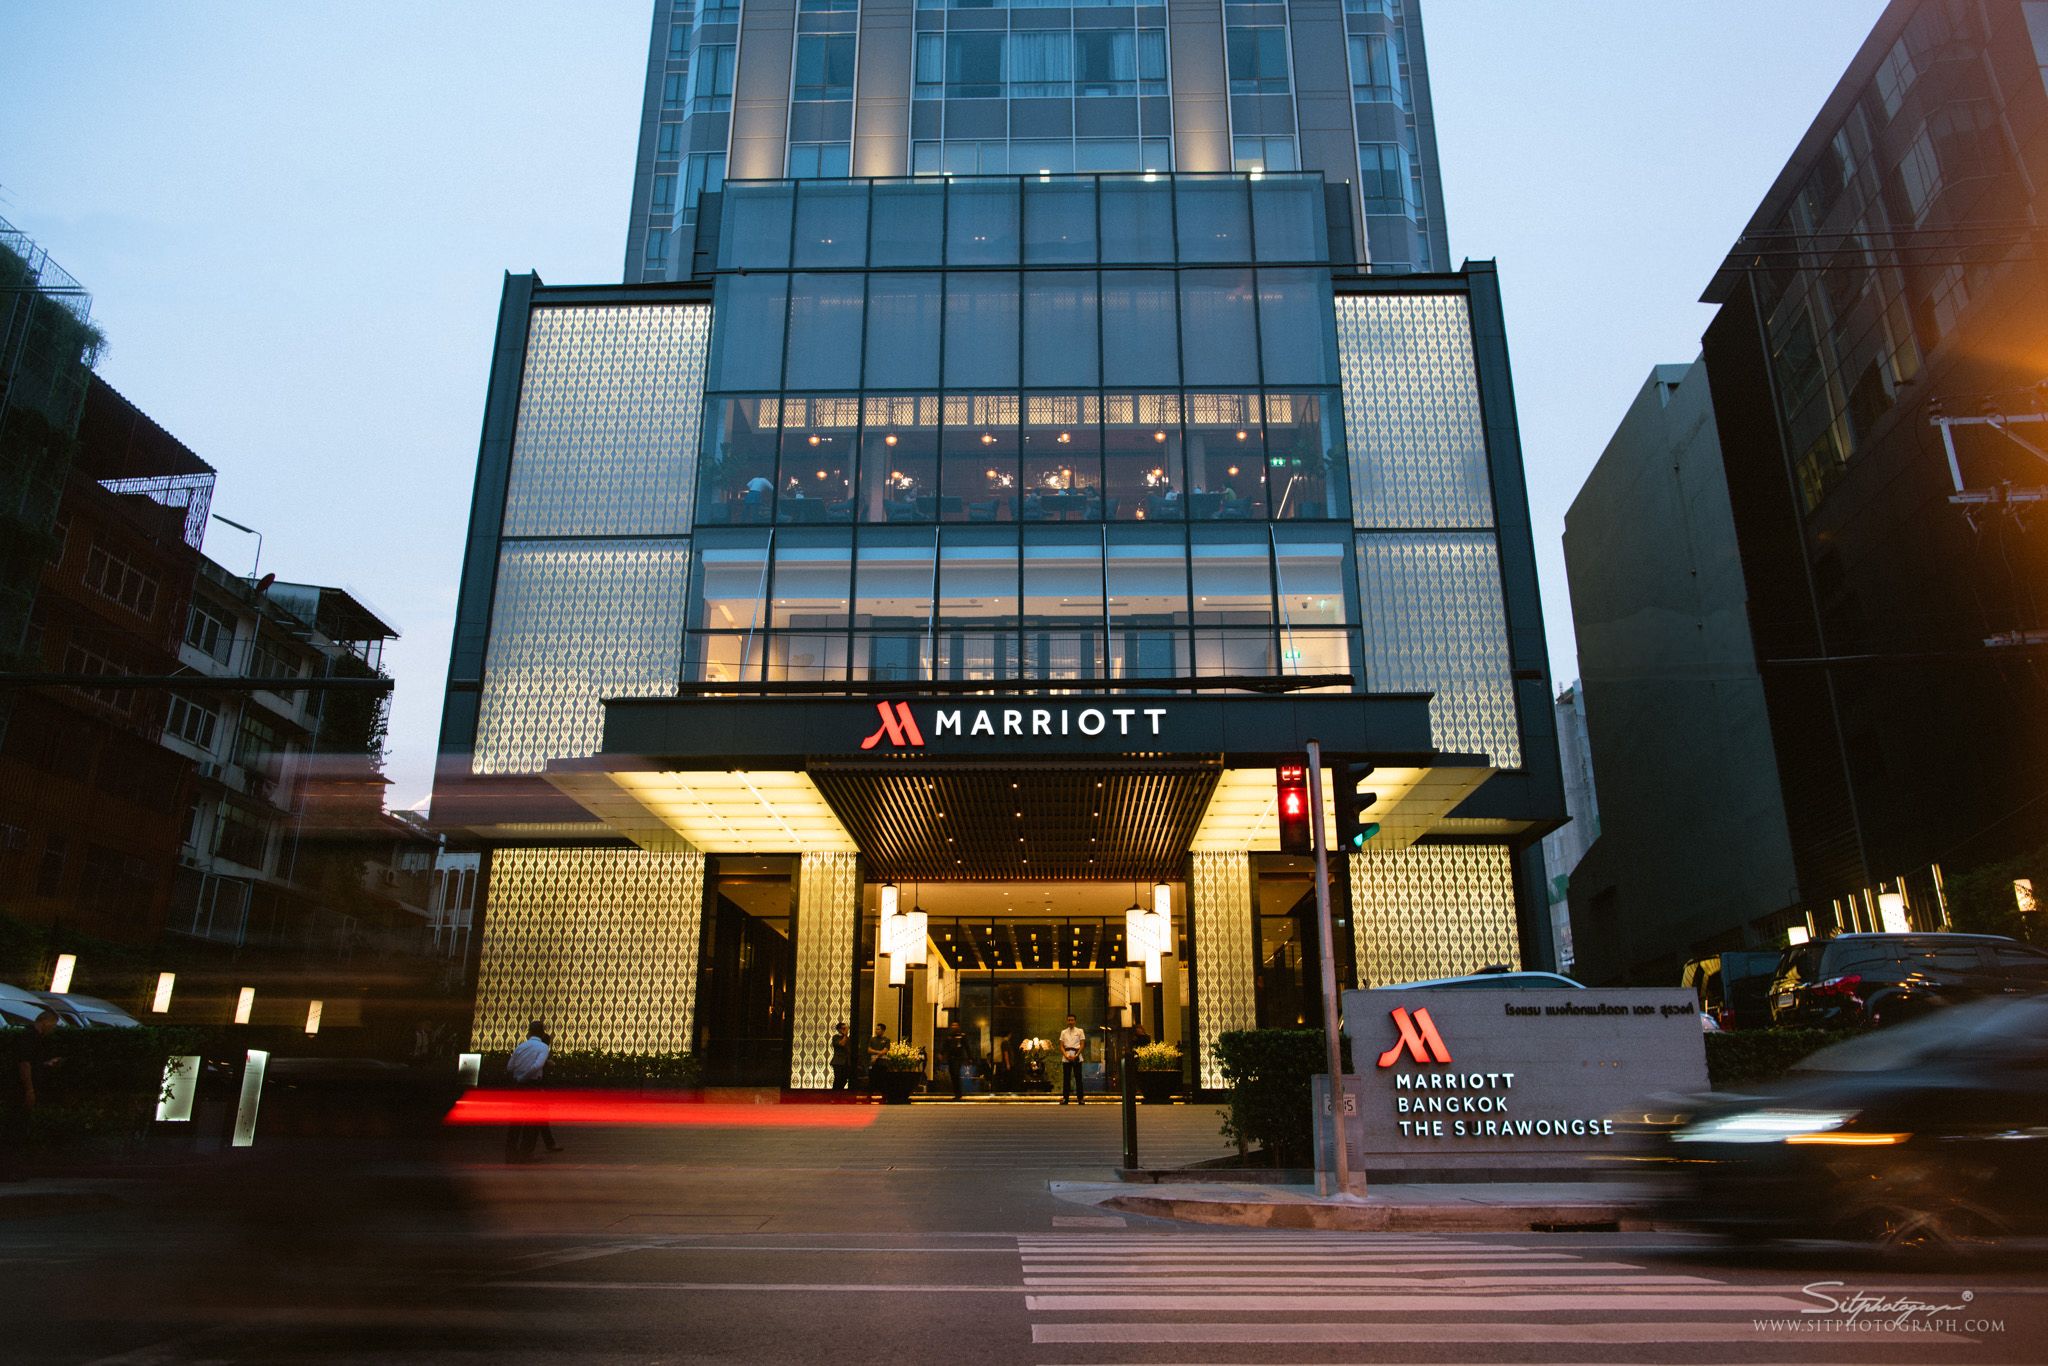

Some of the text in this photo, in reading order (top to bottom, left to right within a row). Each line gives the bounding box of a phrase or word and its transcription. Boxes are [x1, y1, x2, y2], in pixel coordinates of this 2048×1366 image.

[935, 708, 1167, 736] MARRIOTT
[1396, 1073, 1515, 1089] MARRIOTT
[1398, 1096, 1508, 1113] BANGKOK
[1399, 1119, 1614, 1136] THE SURAWONGSE
